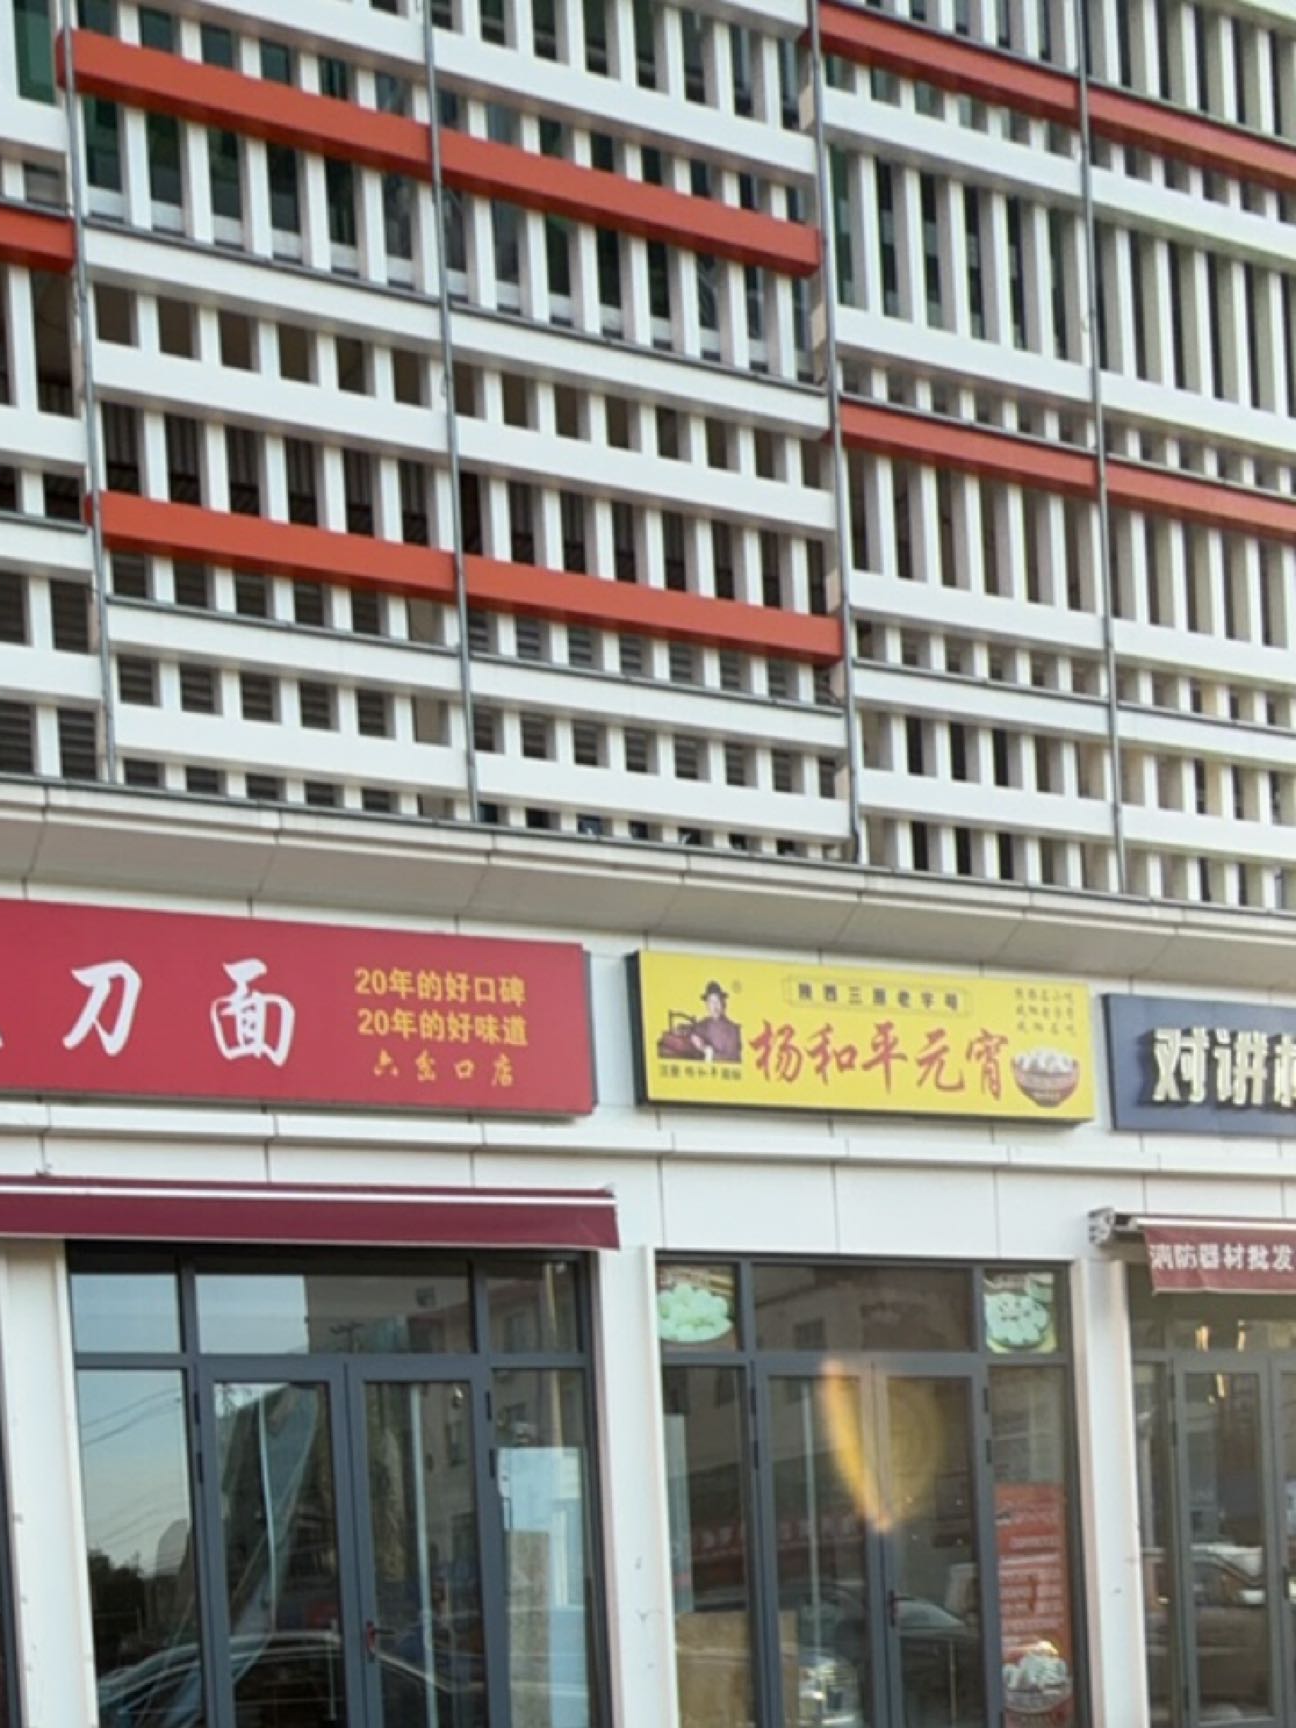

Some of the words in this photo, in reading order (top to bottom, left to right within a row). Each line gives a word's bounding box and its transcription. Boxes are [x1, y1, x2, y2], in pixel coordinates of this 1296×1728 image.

[355, 967, 526, 1007] 20年的好口碑
[357, 1007, 528, 1046] 20年的好味道
[749, 1019, 1009, 1100] 杨和平元宵
[1149, 1243, 1293, 1272] 消防器材批发
